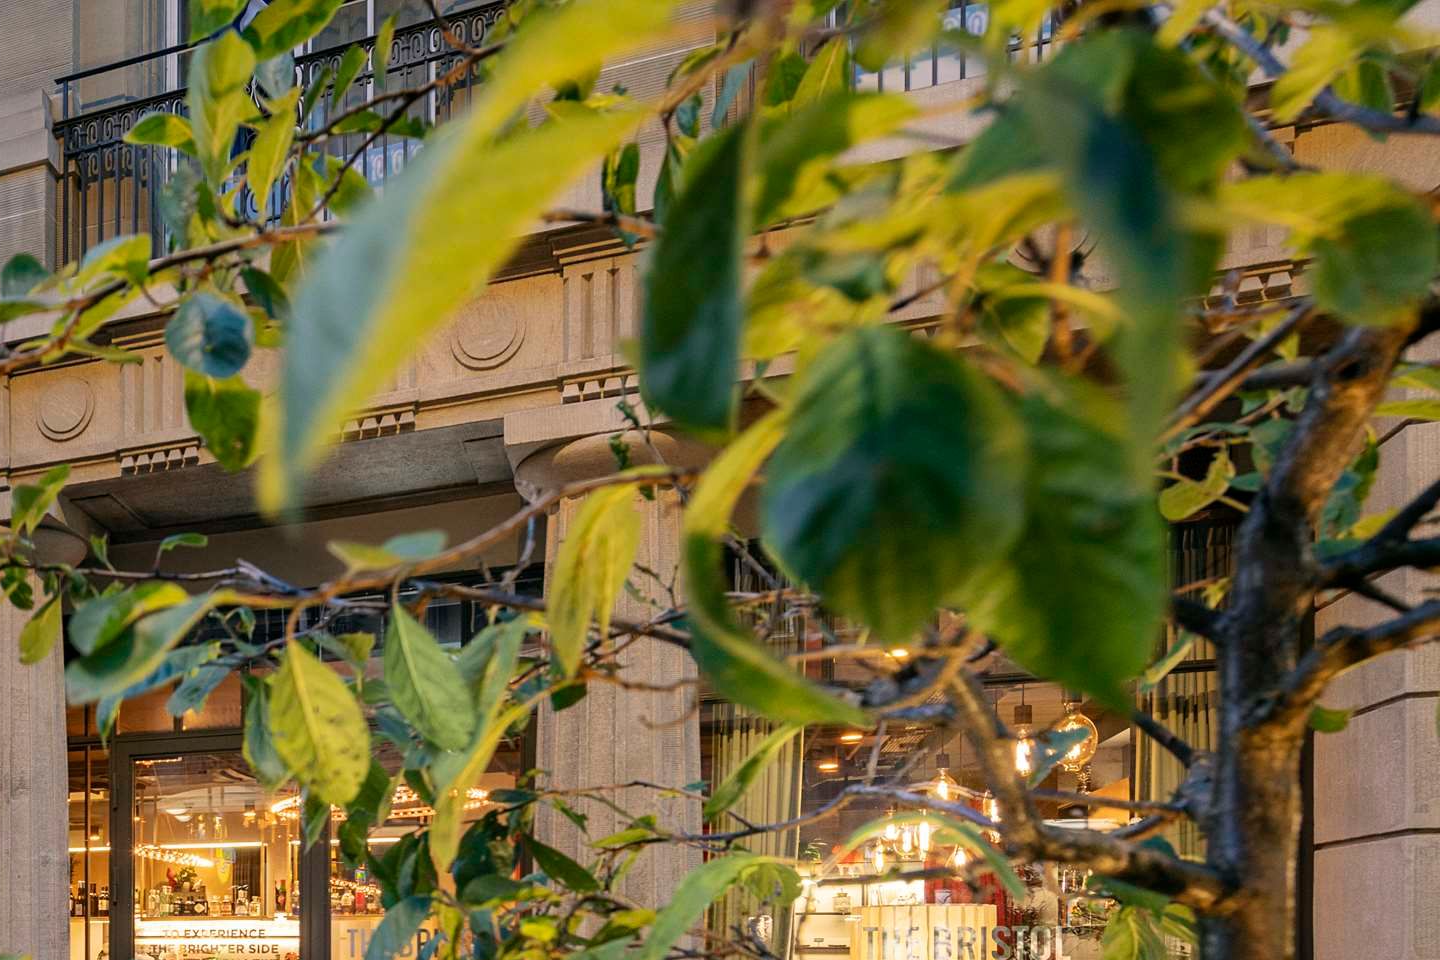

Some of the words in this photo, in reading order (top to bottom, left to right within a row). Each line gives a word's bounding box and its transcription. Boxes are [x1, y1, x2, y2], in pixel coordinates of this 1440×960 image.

[184, 929, 267, 939] EXPERIENCE
[863, 926, 920, 960] THE
[180, 944, 245, 954] BRIGHTER
[249, 944, 279, 954] SIDE
